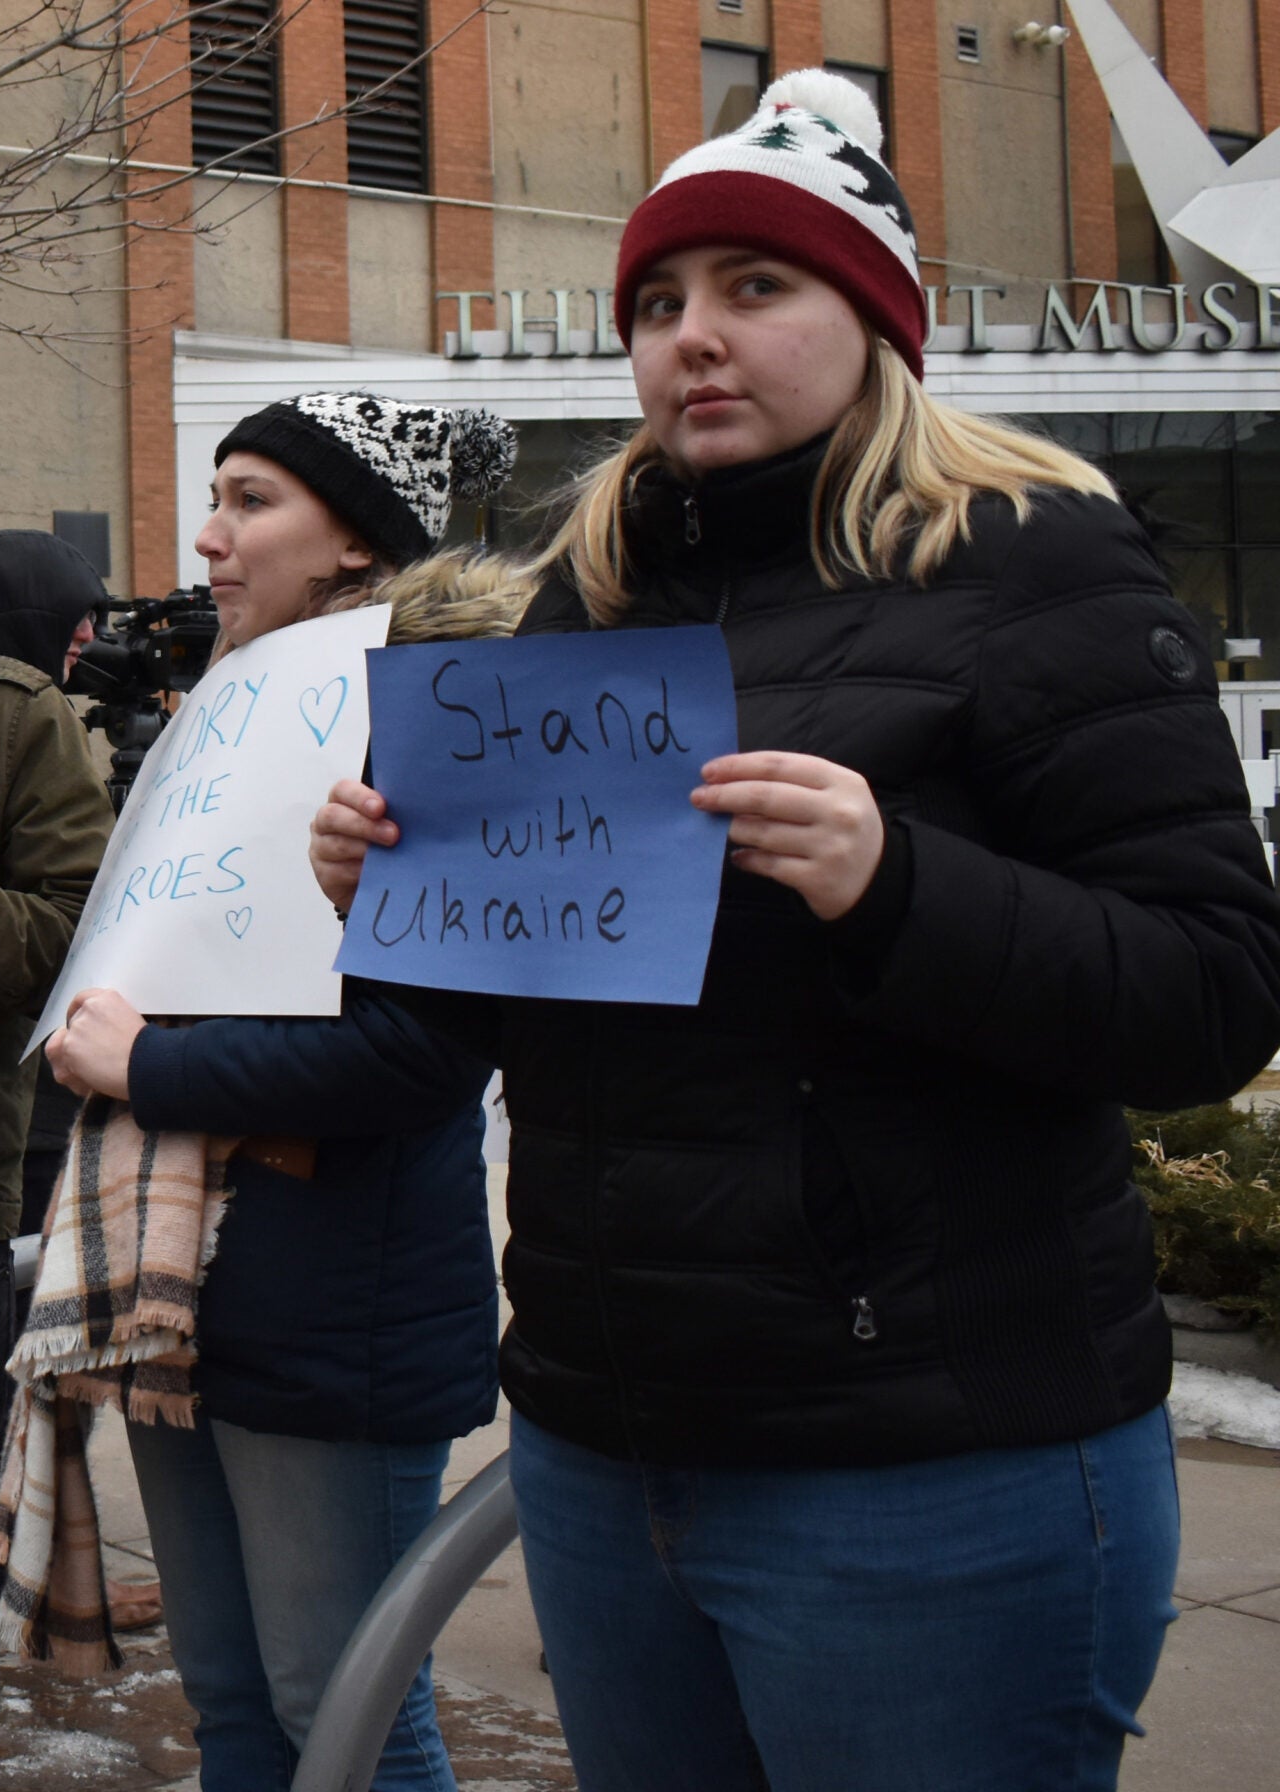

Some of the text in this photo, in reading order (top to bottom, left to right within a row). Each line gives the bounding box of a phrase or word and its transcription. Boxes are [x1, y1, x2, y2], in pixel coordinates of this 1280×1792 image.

[144, 672, 269, 795] LORY
[432, 660, 691, 762] Stand
[157, 772, 231, 827] THE
[481, 794, 613, 858] with
[372, 878, 626, 948] Ukraine
